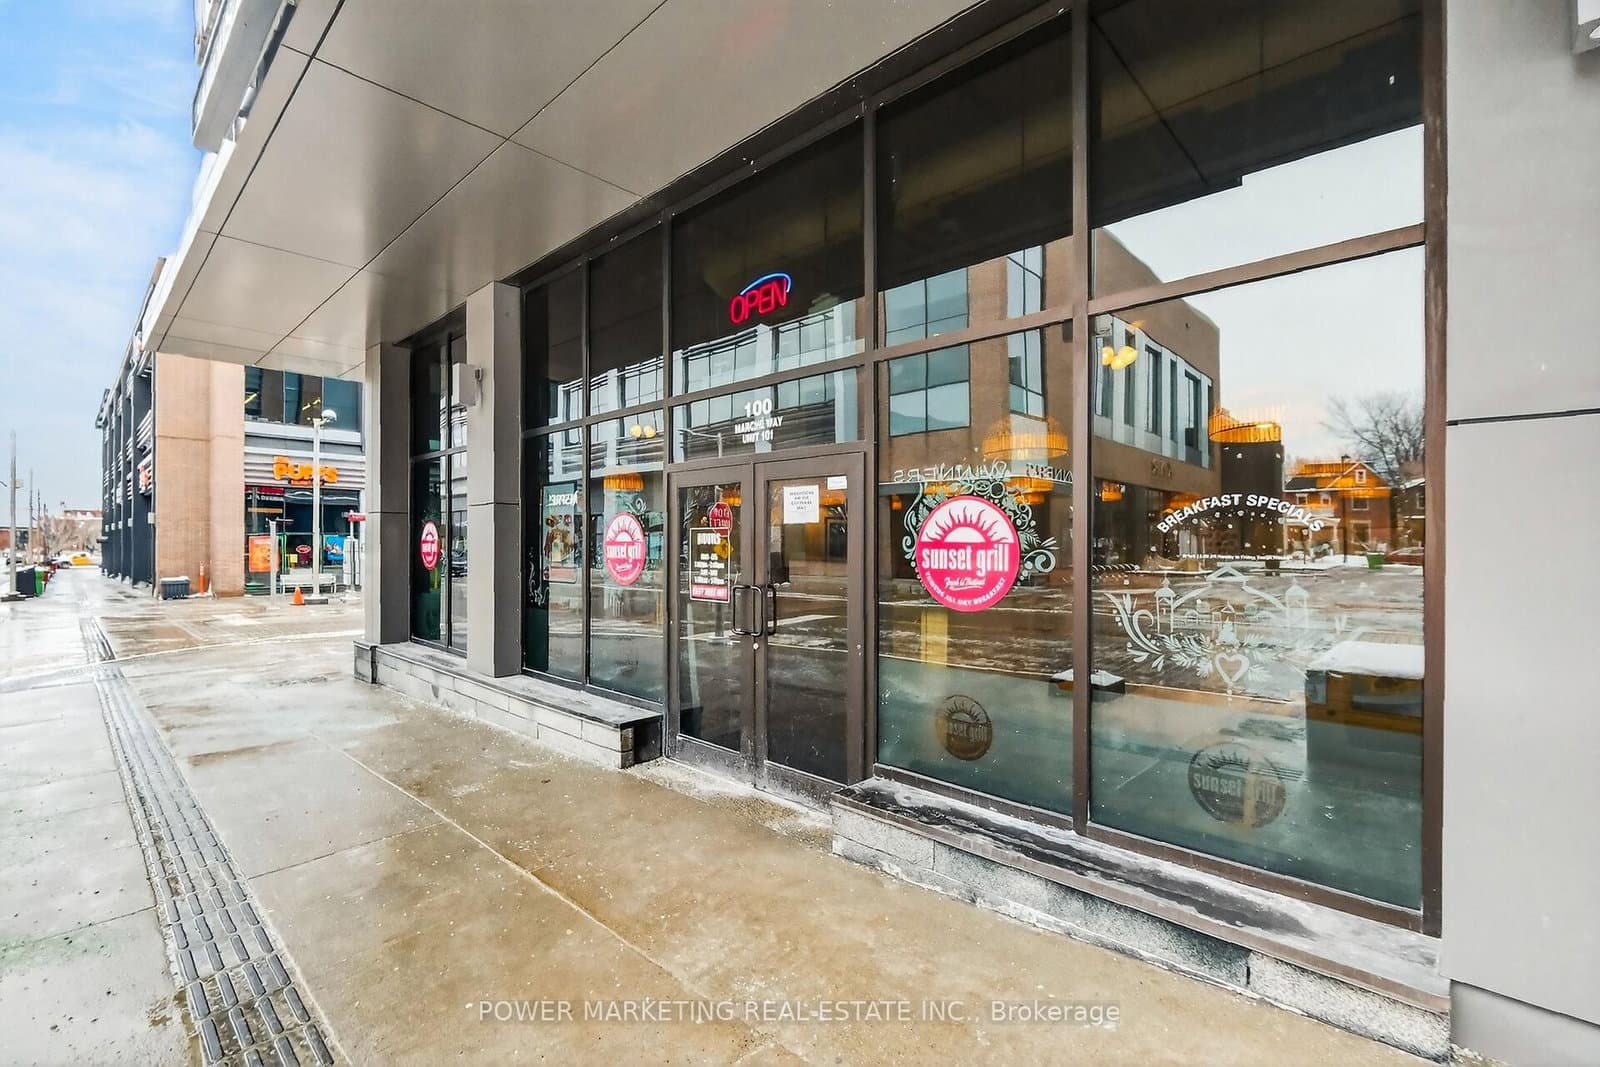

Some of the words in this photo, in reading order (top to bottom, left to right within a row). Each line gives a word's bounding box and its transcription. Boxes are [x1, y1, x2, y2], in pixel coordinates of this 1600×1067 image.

[730, 278, 787, 324] OPEN
[744, 398, 772, 418] 100
[742, 431, 760, 444] UNIT
[761, 429, 774, 441] 101
[765, 416, 783, 430] WAY
[1156, 494, 1242, 534] BREAKFAST
[1246, 494, 1325, 533] SPECIALS
[922, 545, 972, 570] sunset
[976, 543, 1009, 577] grill
